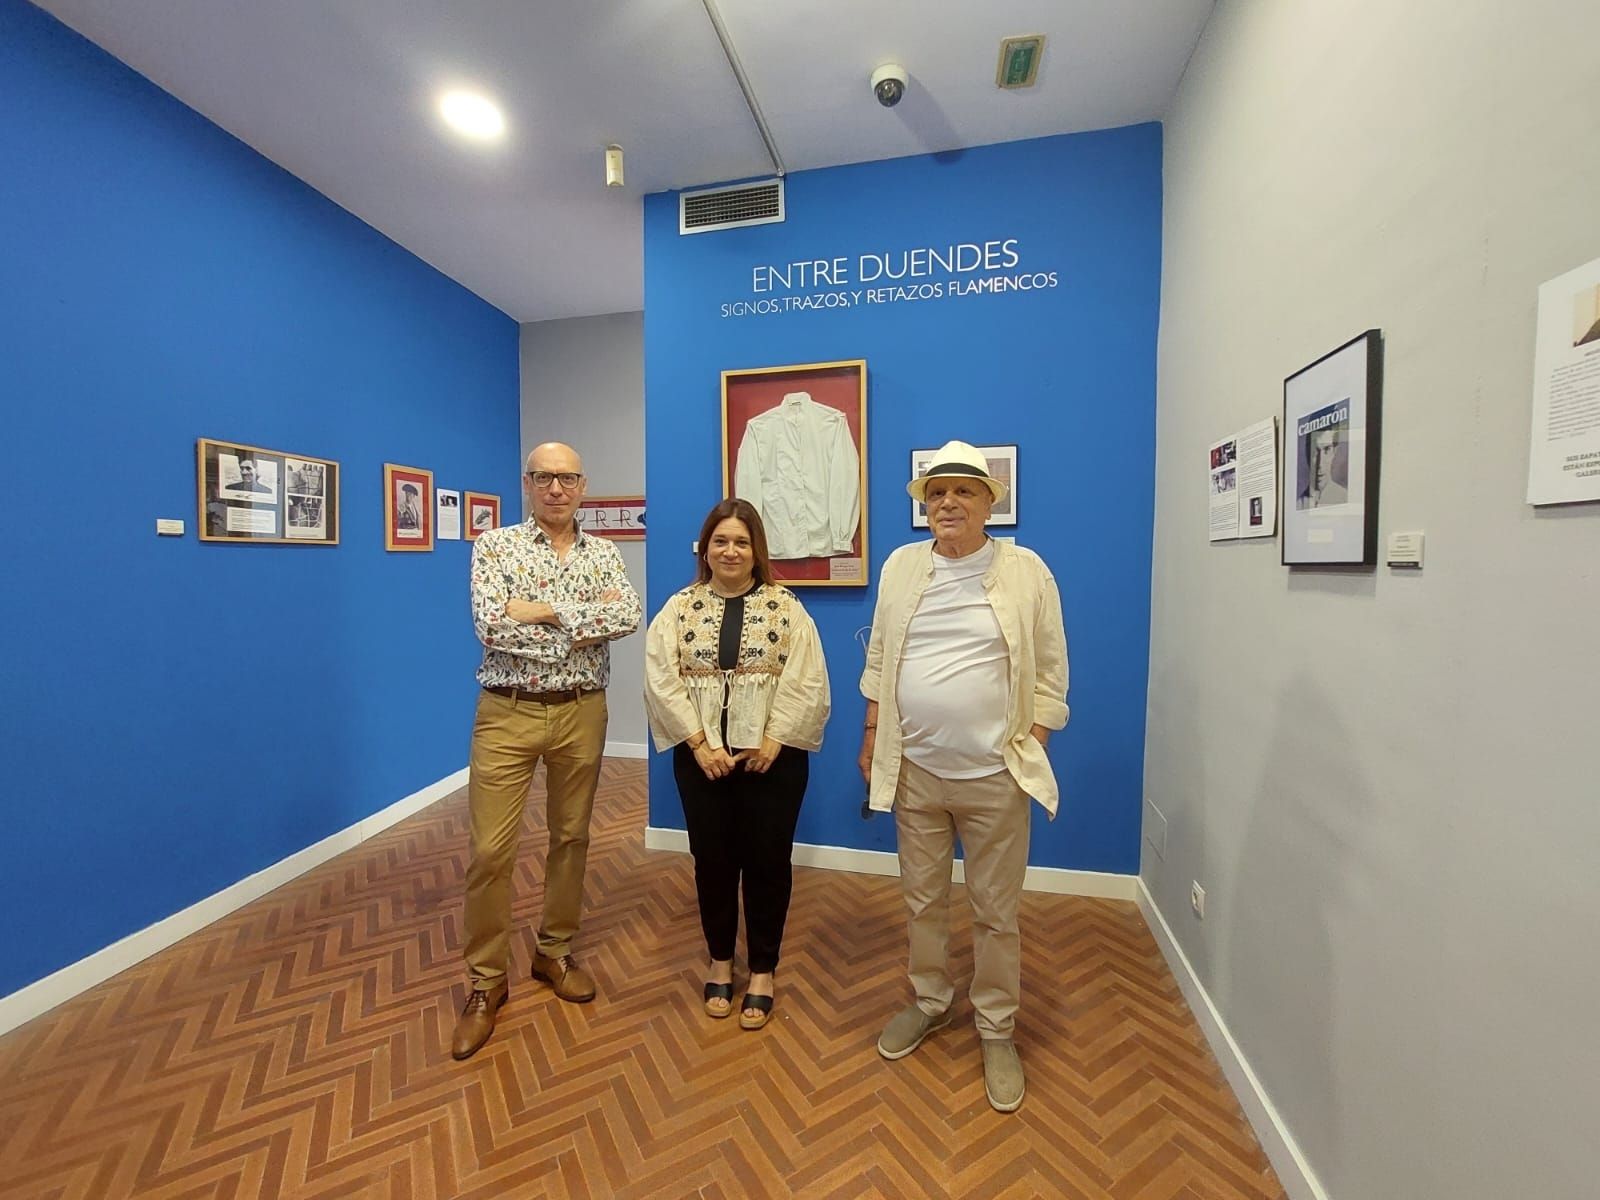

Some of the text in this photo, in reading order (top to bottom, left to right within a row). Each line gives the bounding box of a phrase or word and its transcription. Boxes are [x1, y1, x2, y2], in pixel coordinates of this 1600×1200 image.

[752, 239, 1019, 293] ENTRE DUENDES
[866, 282, 943, 305] RETAZOS
[948, 271, 1059, 298] FLAMENCOS
[1298, 404, 1348, 437] camarón
